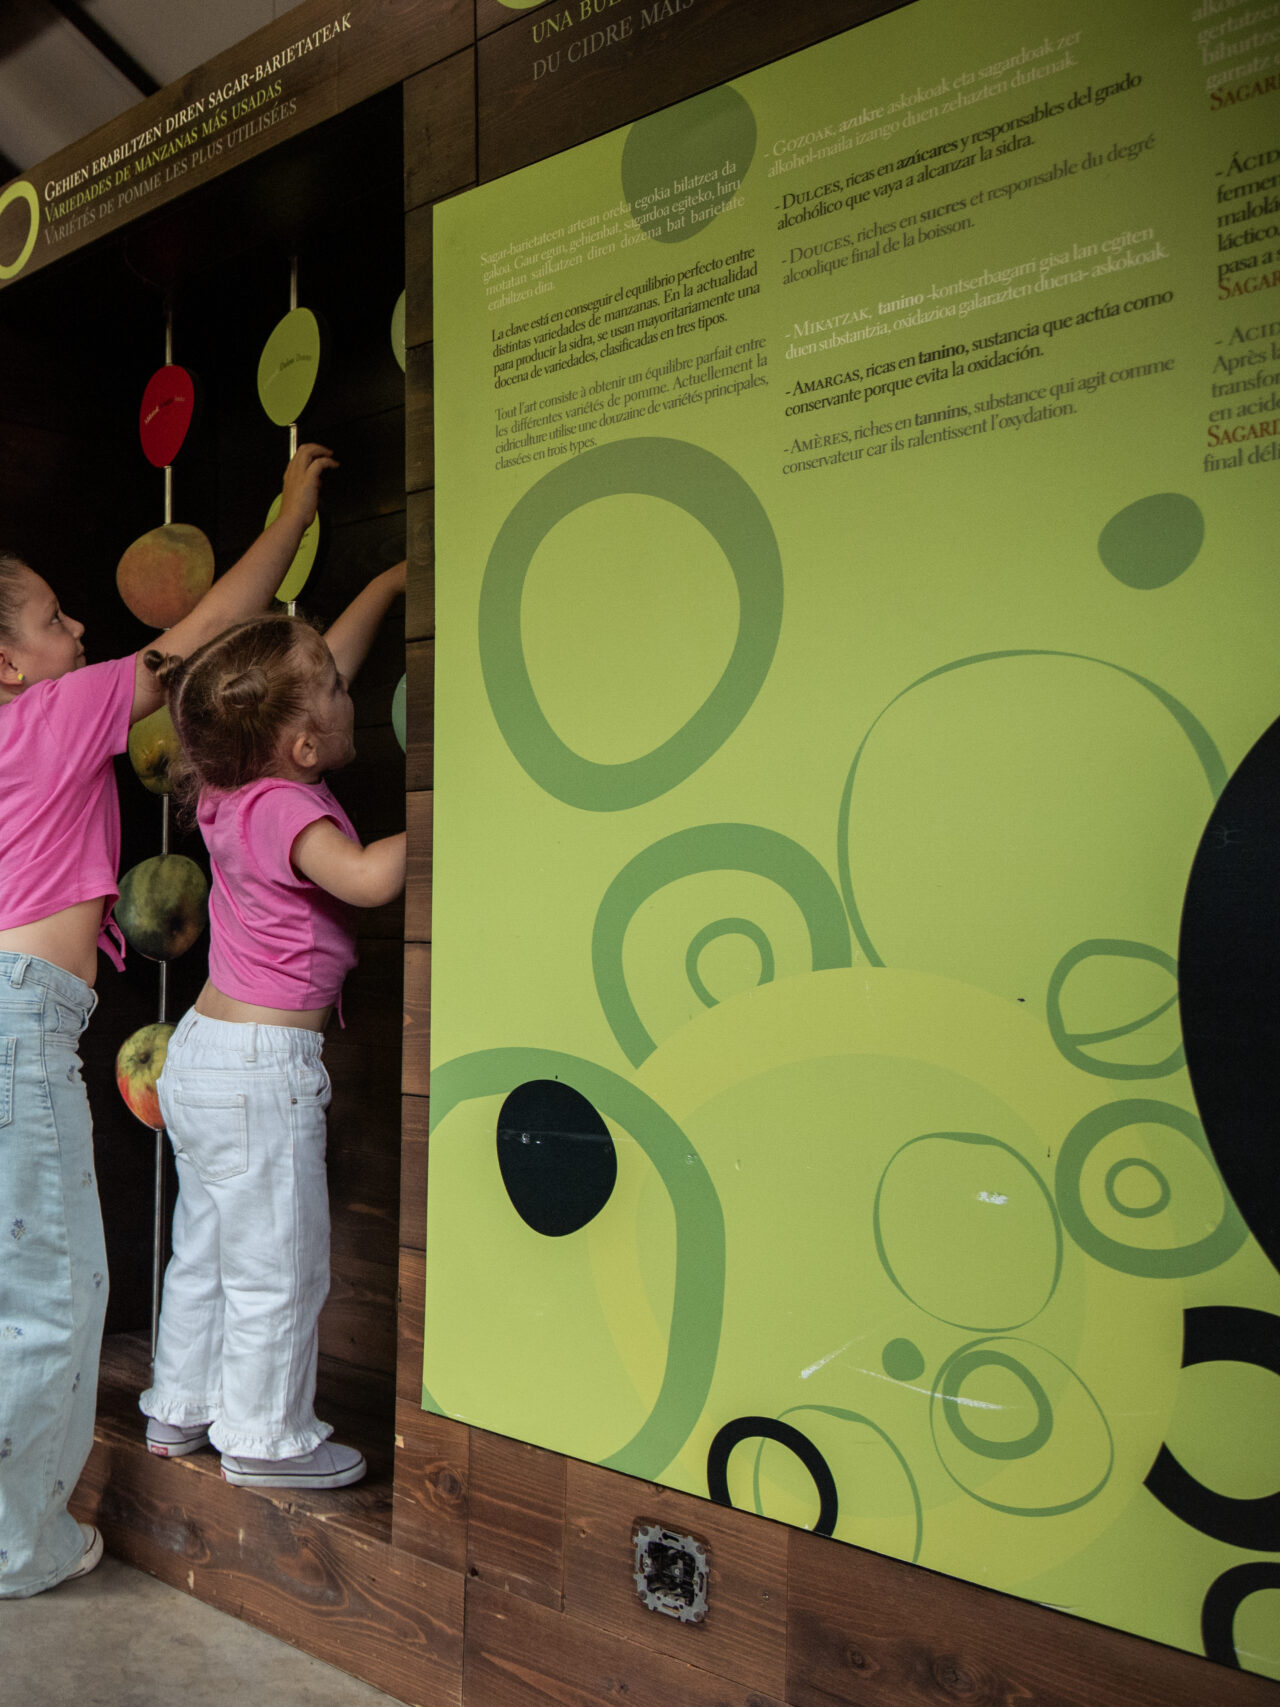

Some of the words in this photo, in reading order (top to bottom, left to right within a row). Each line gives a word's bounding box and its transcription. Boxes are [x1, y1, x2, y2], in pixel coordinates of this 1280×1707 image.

[532, 9, 573, 43] UNA
[532, 51, 560, 80] DU
[567, 15, 632, 63] CIDRE
[44, 162, 88, 203] GEHIEN
[92, 120, 161, 175] ERABILTZEN
[166, 95, 204, 132] DIREN
[208, 11, 351, 108] SAGAR-BARIETATEAK
[782, 181, 842, 209] DULCES,
[846, 168, 874, 187] ricas
[877, 162, 893, 176] en
[896, 140, 958, 169] azúcares
[960, 136, 968, 152] y
[972, 103, 1063, 144] responsables
[1067, 88, 1091, 110] del
[1095, 74, 1141, 105] grado
[44, 204, 94, 246] VARIÉTÉS
[99, 195, 114, 217] DE
[117, 170, 161, 207] POMME
[166, 156, 187, 181] LES
[192, 137, 221, 167] PLUS
[227, 97, 296, 148] UTILISÉES
[45, 173, 111, 224] VARIEDADES
[115, 163, 130, 185] DE
[135, 125, 197, 173] MANZANAS
[202, 108, 227, 136] MÁS
[232, 78, 282, 119] USADAS
[777, 199, 842, 229] alcohólico
[846, 190, 870, 211] que
[873, 178, 903, 197] vaya
[906, 175, 914, 186] a
[916, 154, 975, 182] alcanzar
[980, 146, 992, 162] la
[996, 134, 1034, 156] sidra.
[857, 221, 895, 242] riches
[900, 214, 917, 228] en
[920, 198, 966, 222] sucres
[970, 191, 983, 206] et
[987, 160, 1076, 200] responsable
[1081, 152, 1102, 170] du
[1106, 133, 1154, 162] degré
[782, 255, 848, 284] alcoolique
[852, 241, 879, 264] final
[882, 237, 899, 254] de
[903, 232, 915, 248] la
[918, 218, 975, 243] boisson.
[1218, 256, 1258, 283] pasa
[1262, 252, 1272, 265] a
[491, 330, 503, 342] La
[505, 321, 529, 337] clave
[530, 311, 549, 329] está
[550, 311, 562, 322] en
[564, 292, 612, 318] conseguir
[614, 286, 622, 301] el
[625, 272, 674, 300] equilibrio
[677, 258, 722, 285] perfecto
[725, 248, 754, 265] entre
[492, 337, 530, 357] distintas
[533, 319, 585, 344] variedades
[588, 313, 601, 327] de
[604, 298, 659, 322] manzanas.
[663, 289, 680, 303] En
[683, 284, 693, 298] la
[696, 262, 757, 293] actualidad
[494, 359, 513, 377] para
[516, 344, 555, 371] producir
[558, 340, 566, 353] la
[570, 333, 595, 350] sidra,
[597, 330, 608, 341] se
[610, 322, 634, 337] usan
[637, 291, 734, 329] mayoritariamente
[737, 284, 759, 298] una
[494, 371, 528, 389] docena
[530, 364, 542, 378] de
[544, 350, 597, 374] variedades,
[600, 332, 657, 358] clasificadas
[660, 328, 673, 340] en
[676, 322, 695, 336] tres
[698, 313, 727, 332] tipos.
[495, 405, 516, 421] Tout
[519, 400, 536, 415] l'art
[538, 390, 577, 409] consiste
[580, 385, 585, 398] à
[588, 375, 624, 395] obtenir
[628, 373, 642, 384] un
[645, 357, 693, 382] équilibre
[696, 345, 732, 370] parfait
[735, 338, 765, 355] entre
[785, 389, 860, 416] conservante
[864, 377, 912, 402] porque
[915, 367, 948, 385] evita
[952, 362, 964, 377] la
[967, 345, 1043, 373] oxidación.
[792, 370, 862, 396] AMARGAS,
[866, 361, 894, 378] ricas
[898, 356, 915, 369] en
[918, 344, 969, 365] tanino,
[972, 323, 1038, 351] sustancia
[1043, 317, 1071, 337] que
[1075, 303, 1119, 325] actúa
[1124, 291, 1173, 312] como
[1212, 349, 1266, 376] Après
[495, 424, 507, 437] les
[511, 411, 562, 433] différentes
[565, 398, 603, 418] variétés
[607, 393, 620, 407] de
[623, 384, 668, 407] pomme.
[672, 359, 752, 390] Actuellement
[756, 354, 766, 368] la
[495, 432, 546, 454] cidriculture
[548, 424, 576, 440] utilise
[578, 420, 596, 432] une
[599, 407, 645, 427] douzaine
[647, 400, 660, 415] de
[662, 391, 702, 411] variétés
[704, 375, 768, 404] principales,
[854, 422, 891, 440] riches
[894, 418, 912, 431] en
[974, 388, 1046, 413] substance
[1050, 378, 1073, 401] qui
[1077, 372, 1105, 393] agit
[1109, 360, 1174, 383] comme
[1208, 408, 1232, 422] en
[495, 452, 530, 470] classées
[533, 450, 544, 461] en
[547, 442, 567, 457] trois
[569, 437, 596, 455] types.
[782, 449, 862, 475] conservateur
[866, 444, 887, 457] car
[890, 436, 904, 452] ils
[908, 421, 986, 448] ralentissent
[990, 404, 1077, 431] l'oxydation.
[1204, 447, 1243, 472] final
